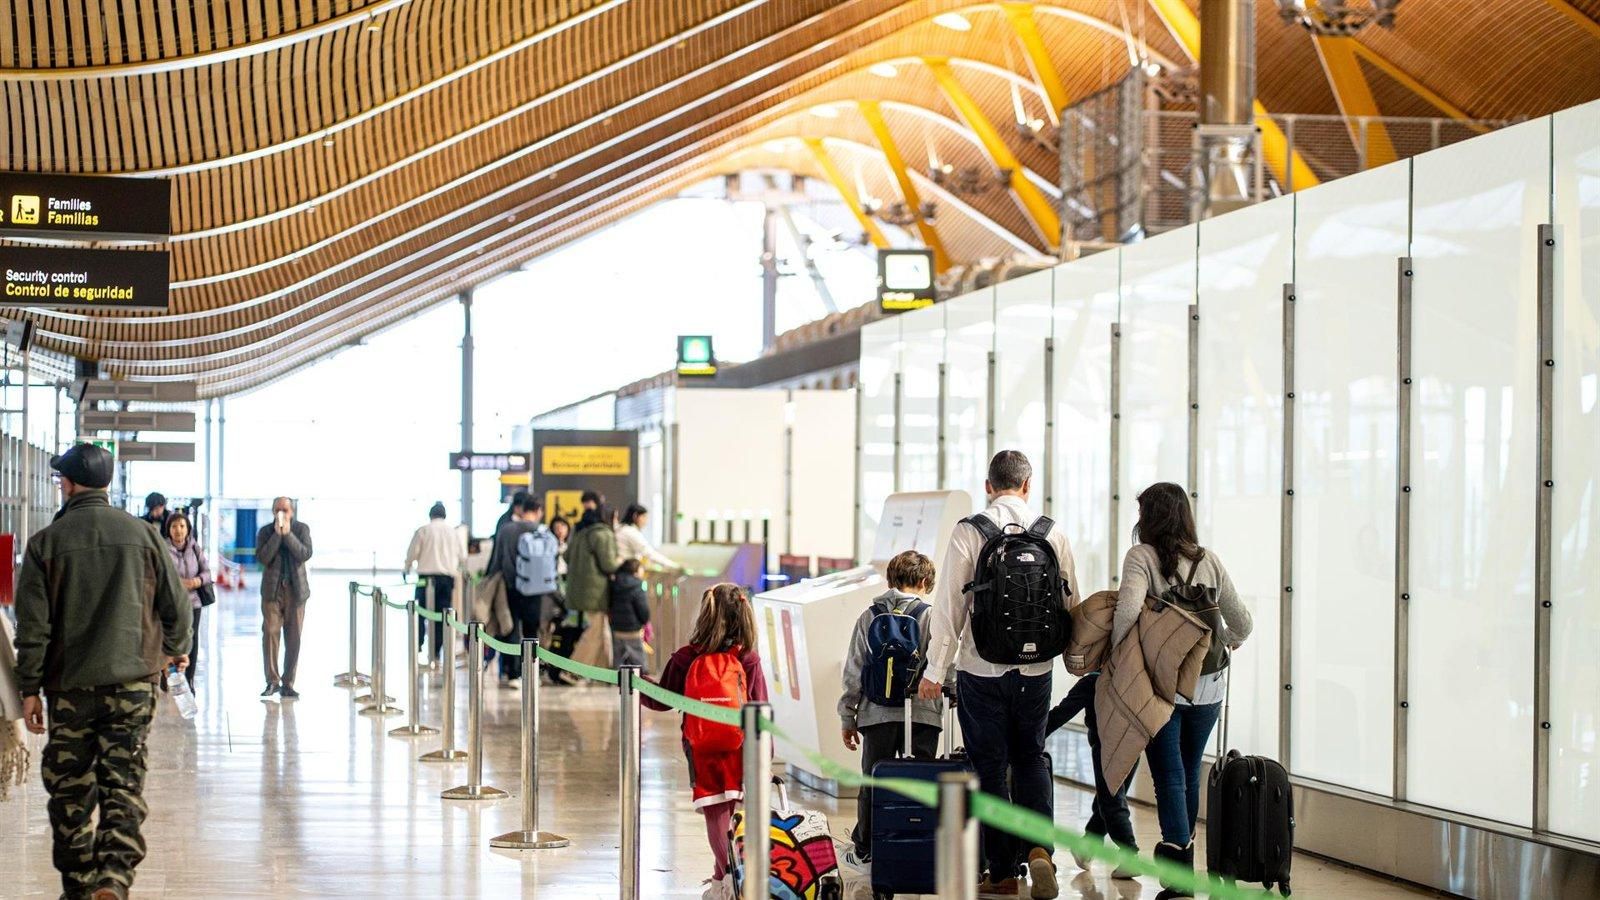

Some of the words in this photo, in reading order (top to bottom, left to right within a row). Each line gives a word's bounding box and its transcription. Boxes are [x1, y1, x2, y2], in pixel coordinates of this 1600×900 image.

[48, 198, 92, 211] Families
[48, 211, 99, 226] Familias
[6, 269, 48, 284] Security
[51, 272, 87, 284] control
[6, 283, 50, 297] Control
[54, 285, 69, 298] de
[73, 286, 133, 300] seguridad
